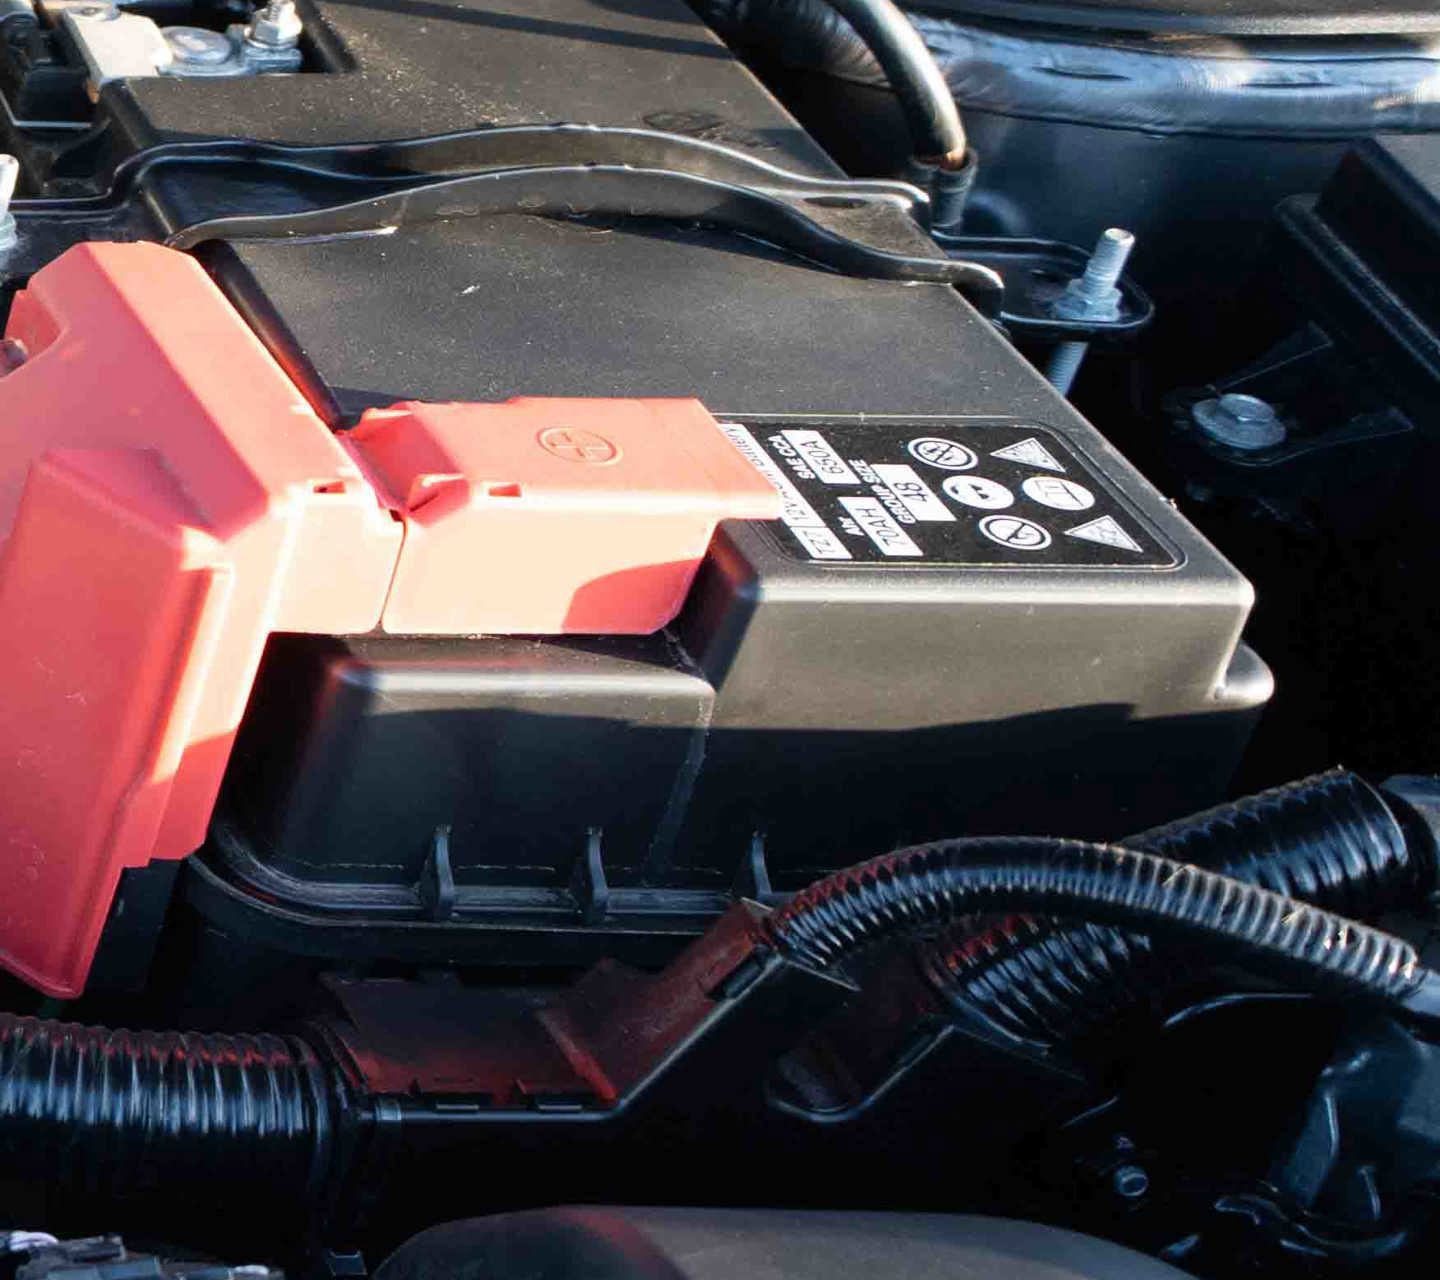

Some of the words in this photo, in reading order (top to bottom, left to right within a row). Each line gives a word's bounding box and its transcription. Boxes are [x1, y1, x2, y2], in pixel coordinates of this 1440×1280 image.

[767, 434, 798, 458] CCA
[799, 440, 845, 475] 650A
[784, 457, 816, 480] SAE
[847, 458, 881, 484] SIZE
[870, 483, 917, 524] GROUP
[892, 481, 929, 503] 48
